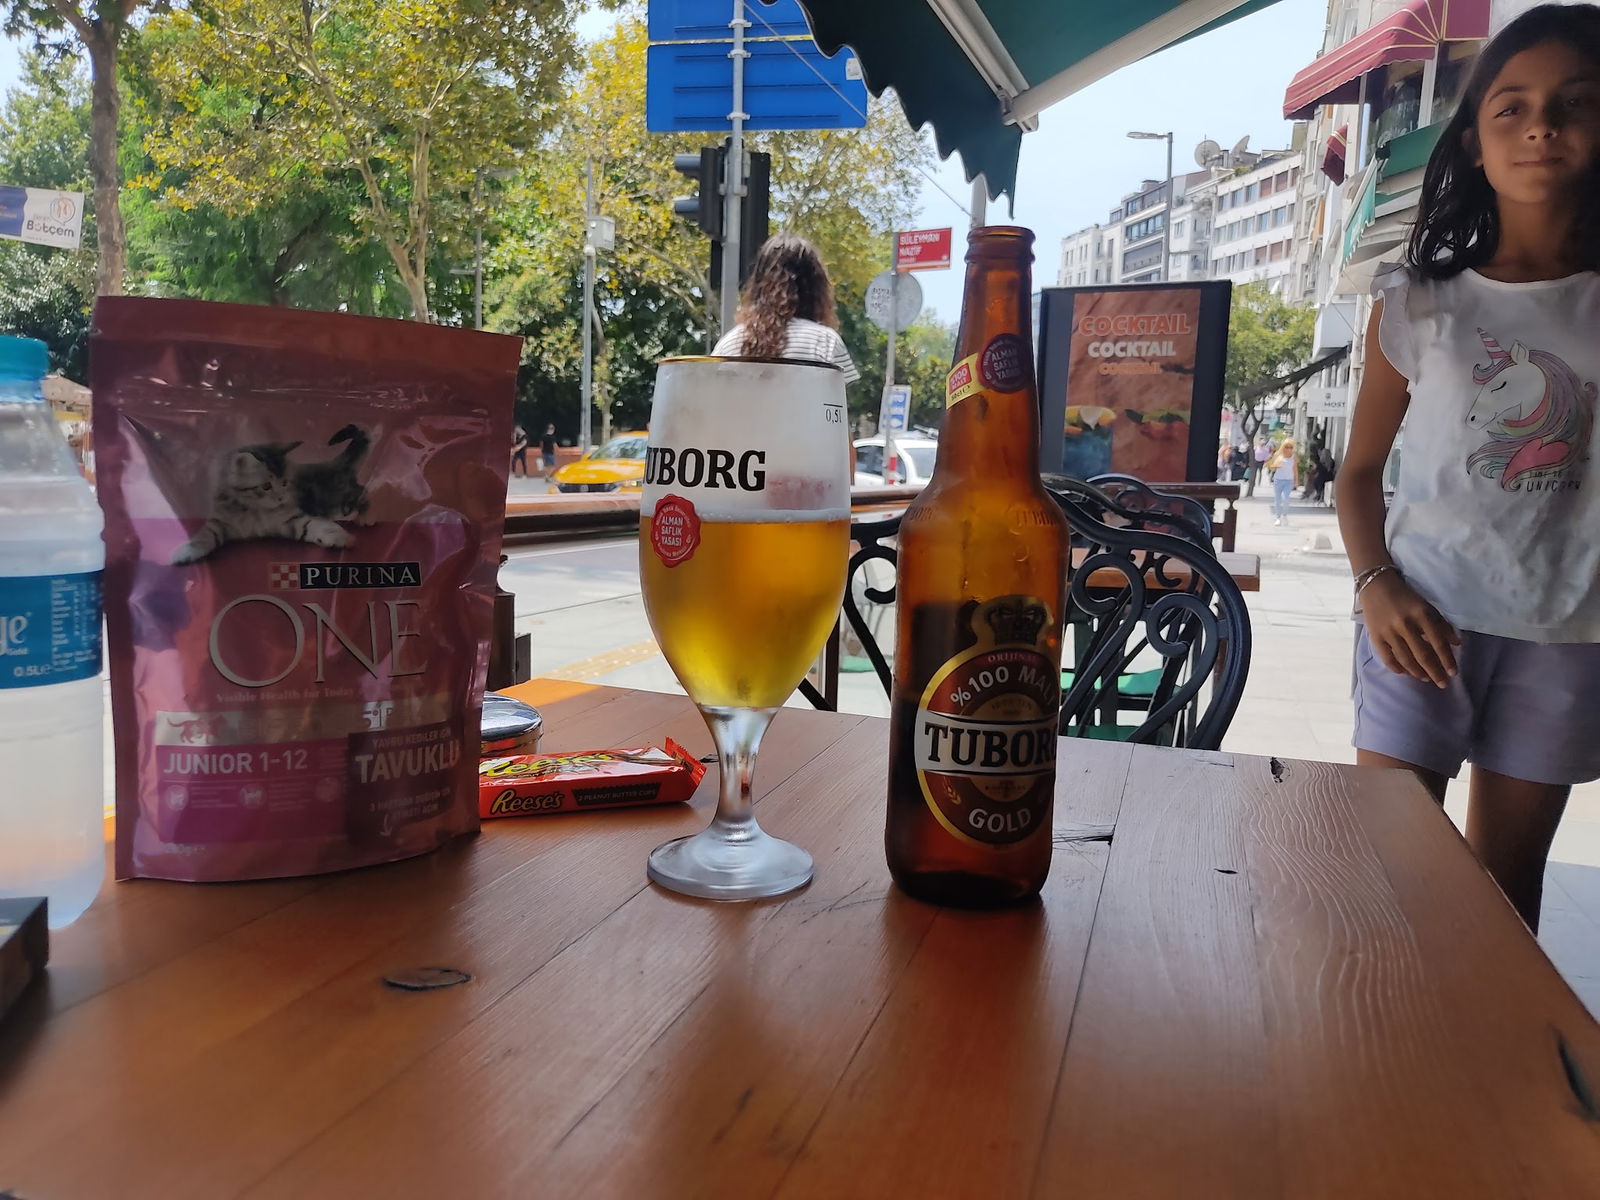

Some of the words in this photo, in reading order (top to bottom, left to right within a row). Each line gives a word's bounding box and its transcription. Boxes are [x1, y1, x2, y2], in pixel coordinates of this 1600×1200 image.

[1078, 313, 1192, 336] COCKTAIL
[1087, 341, 1177, 358] COCKTAIL
[660, 525, 683, 536] SAFLIK
[661, 515, 684, 527] ALMAN
[661, 536, 683, 547] YASASI
[304, 565, 417, 586] PURINA
[209, 594, 428, 689] ONE
[260, 690, 301, 700] Health
[950, 665, 1009, 707] %100
[163, 752, 254, 775] JUNIOR
[259, 748, 308, 773] 1-12
[354, 738, 461, 784] TAVUKLU
[490, 789, 565, 814] Reese's
[584, 792, 610, 802] PEANUT
[612, 790, 637, 799] BUTTER
[638, 789, 656, 797] CUPS
[968, 807, 1032, 833] GOLD
